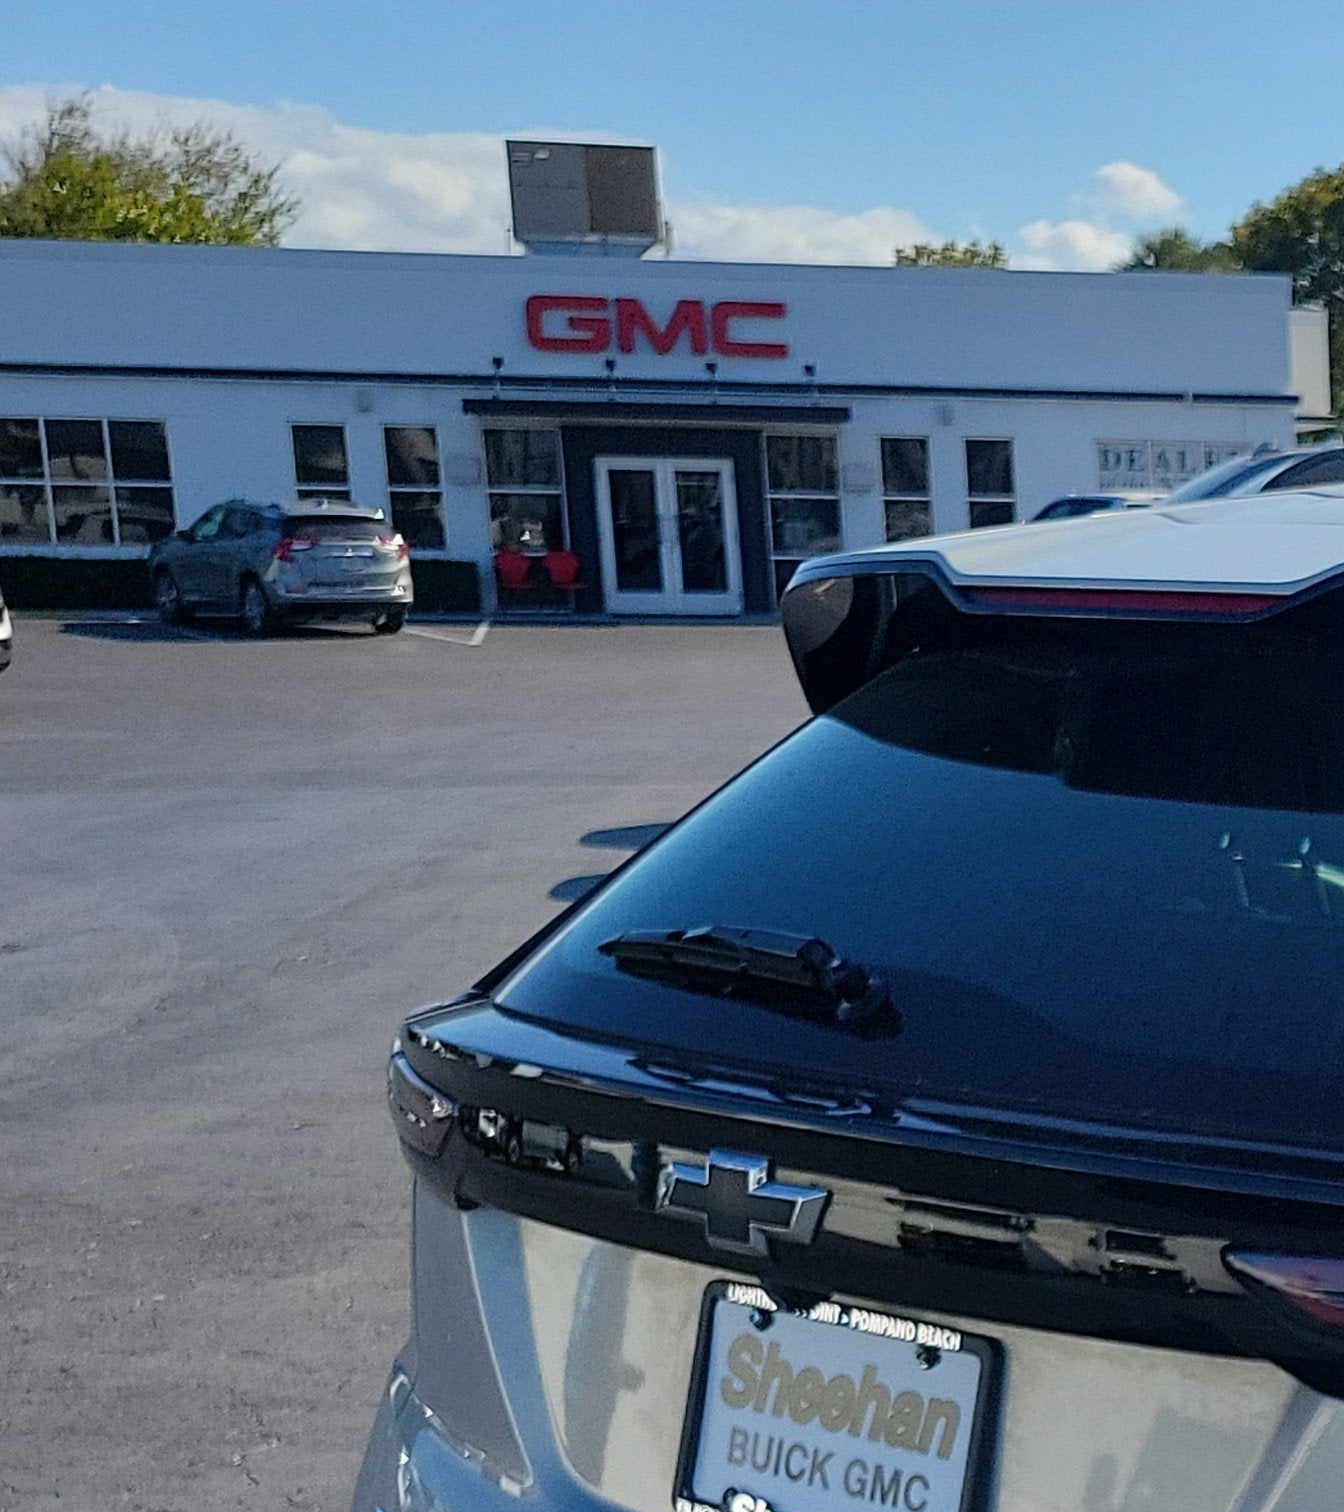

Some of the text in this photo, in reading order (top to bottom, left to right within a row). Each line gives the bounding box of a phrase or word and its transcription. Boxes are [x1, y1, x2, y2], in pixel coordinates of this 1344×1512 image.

[527, 295, 787, 357] GMC
[1101, 449, 1238, 473] DEALE
[850, 1308, 917, 1342] POMPANO
[917, 1323, 962, 1352] BEACH
[721, 1334, 961, 1460] Sheehan
[727, 1426, 835, 1490] BUICK
